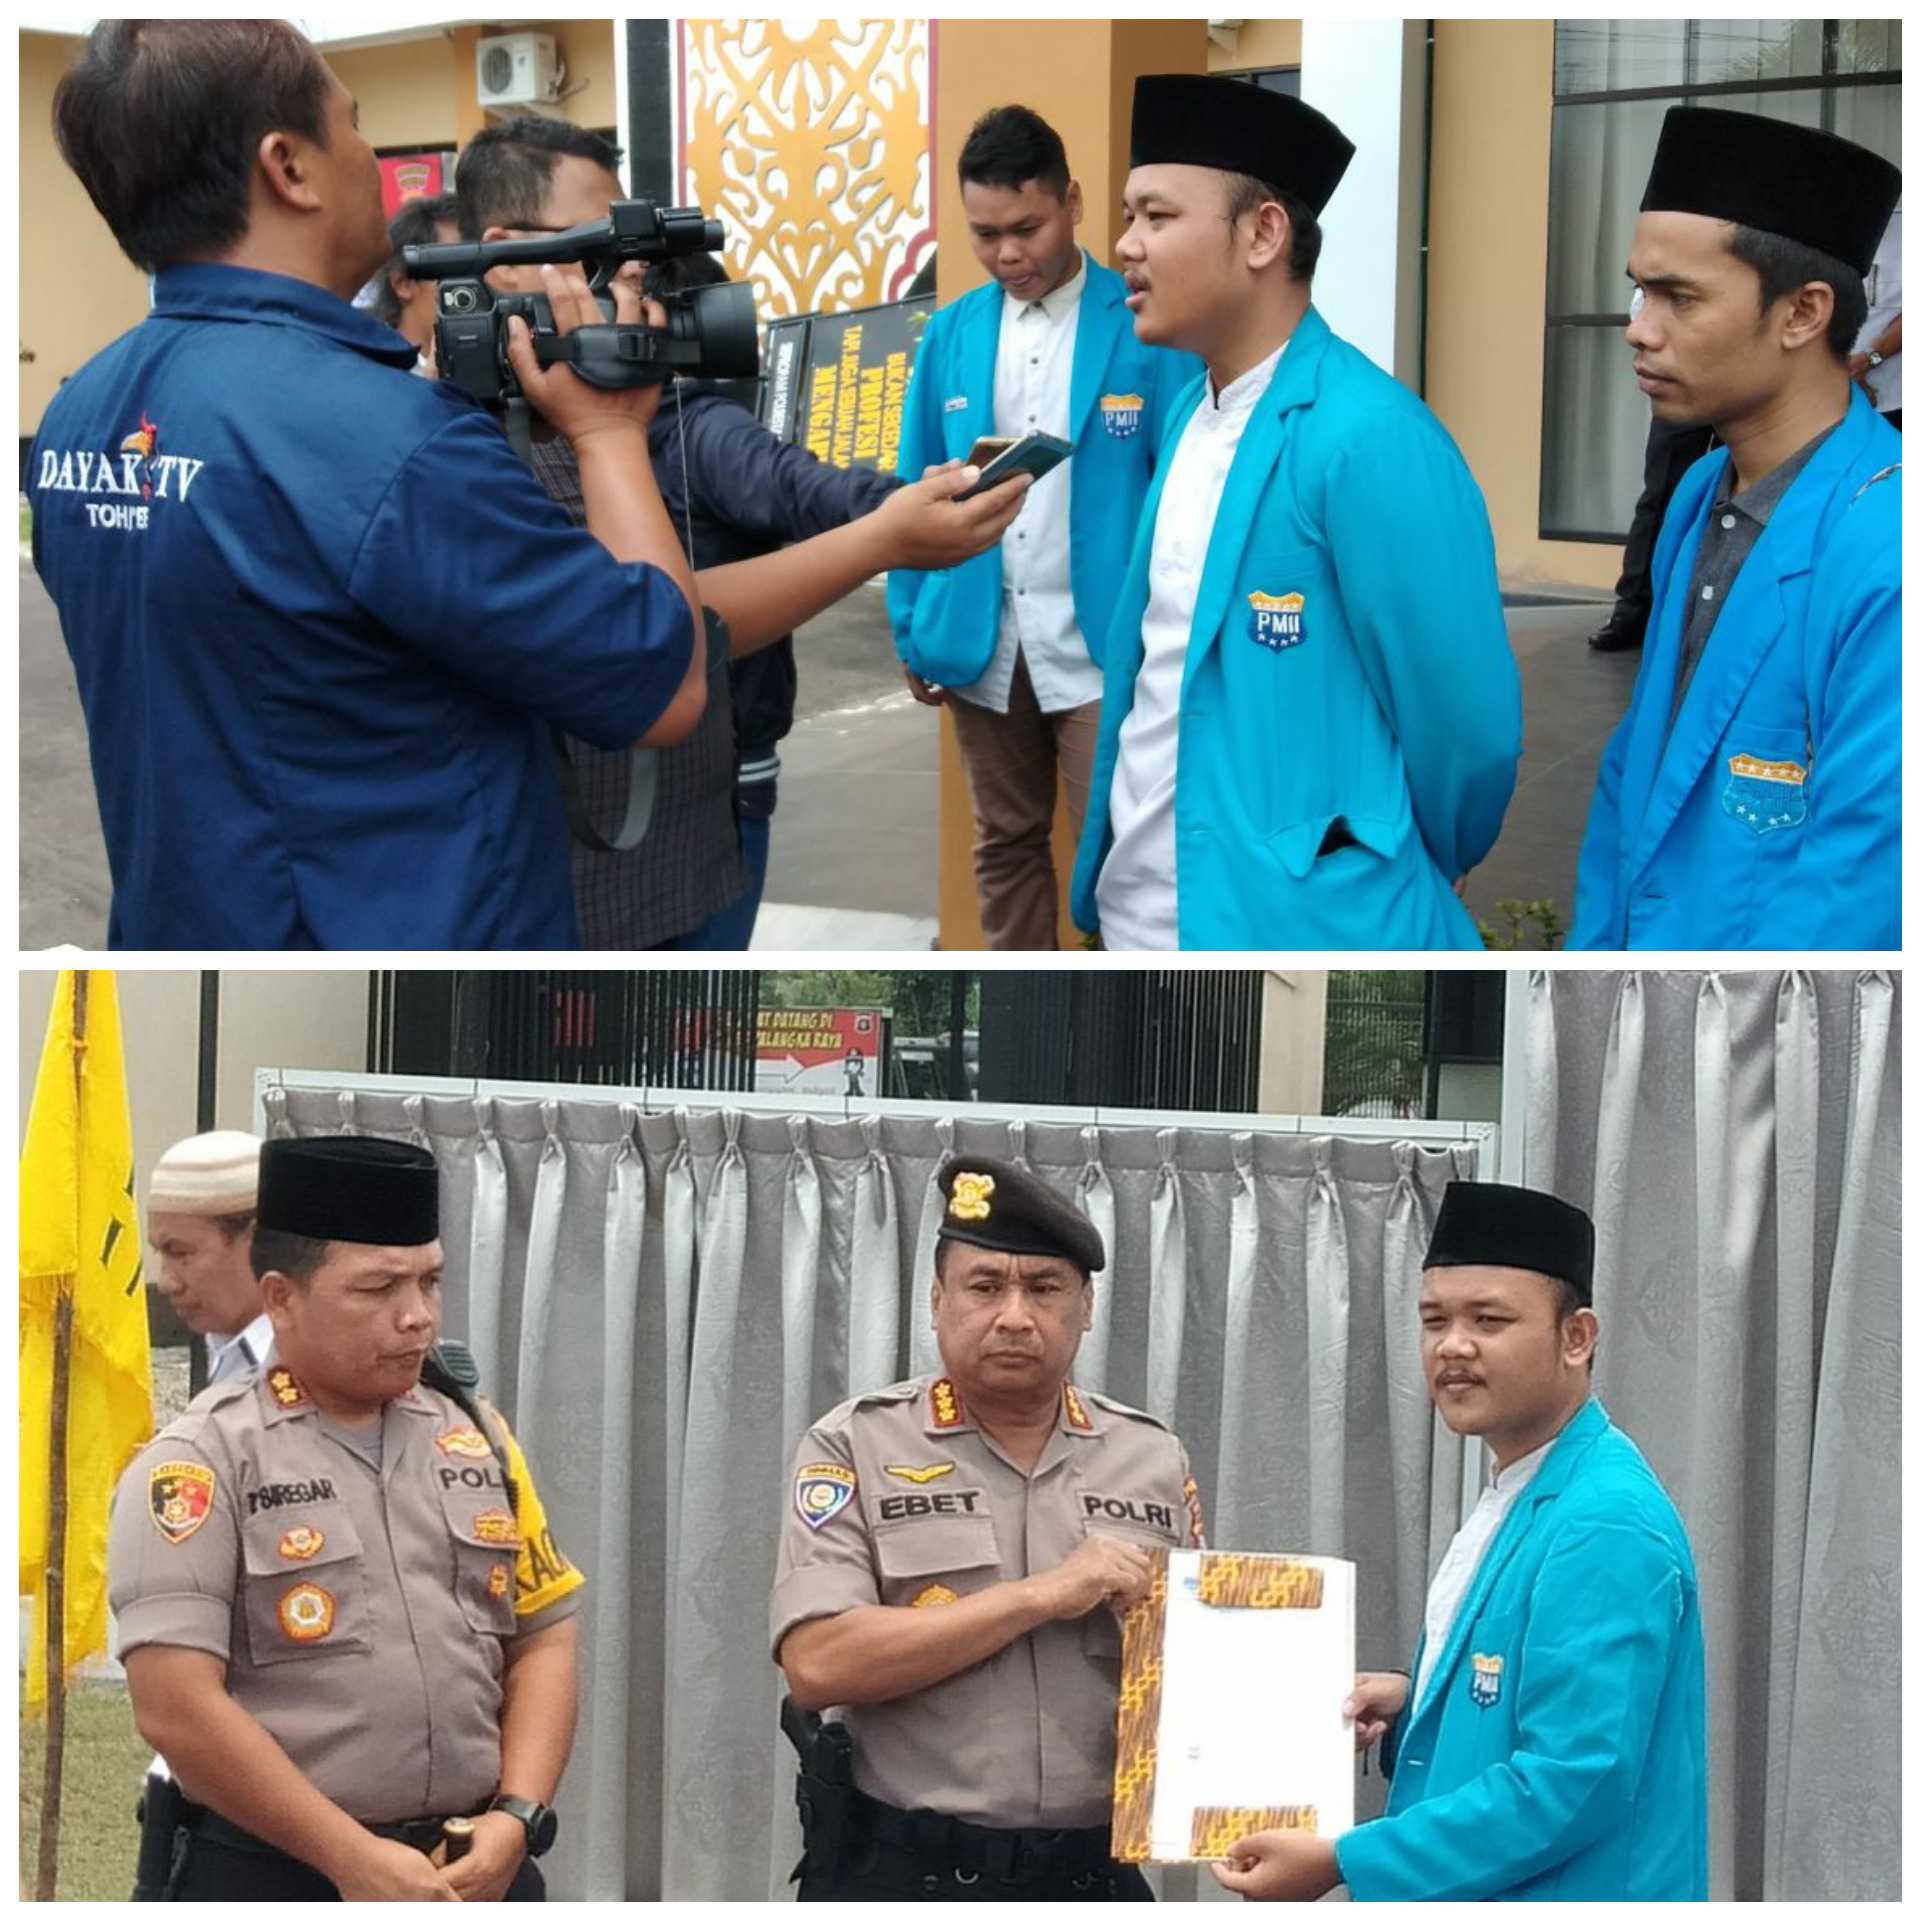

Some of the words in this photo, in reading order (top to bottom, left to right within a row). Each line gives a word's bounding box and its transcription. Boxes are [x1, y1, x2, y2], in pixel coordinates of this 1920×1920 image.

[853, 366, 885, 459] PROFESI
[1105, 410, 1138, 427] PMII
[37, 449, 141, 496] DAYAK
[154, 455, 204, 502] TV
[1257, 612, 1300, 634] PMII
[880, 1490, 980, 1520] EBET
[1082, 1495, 1172, 1529] POLRI
